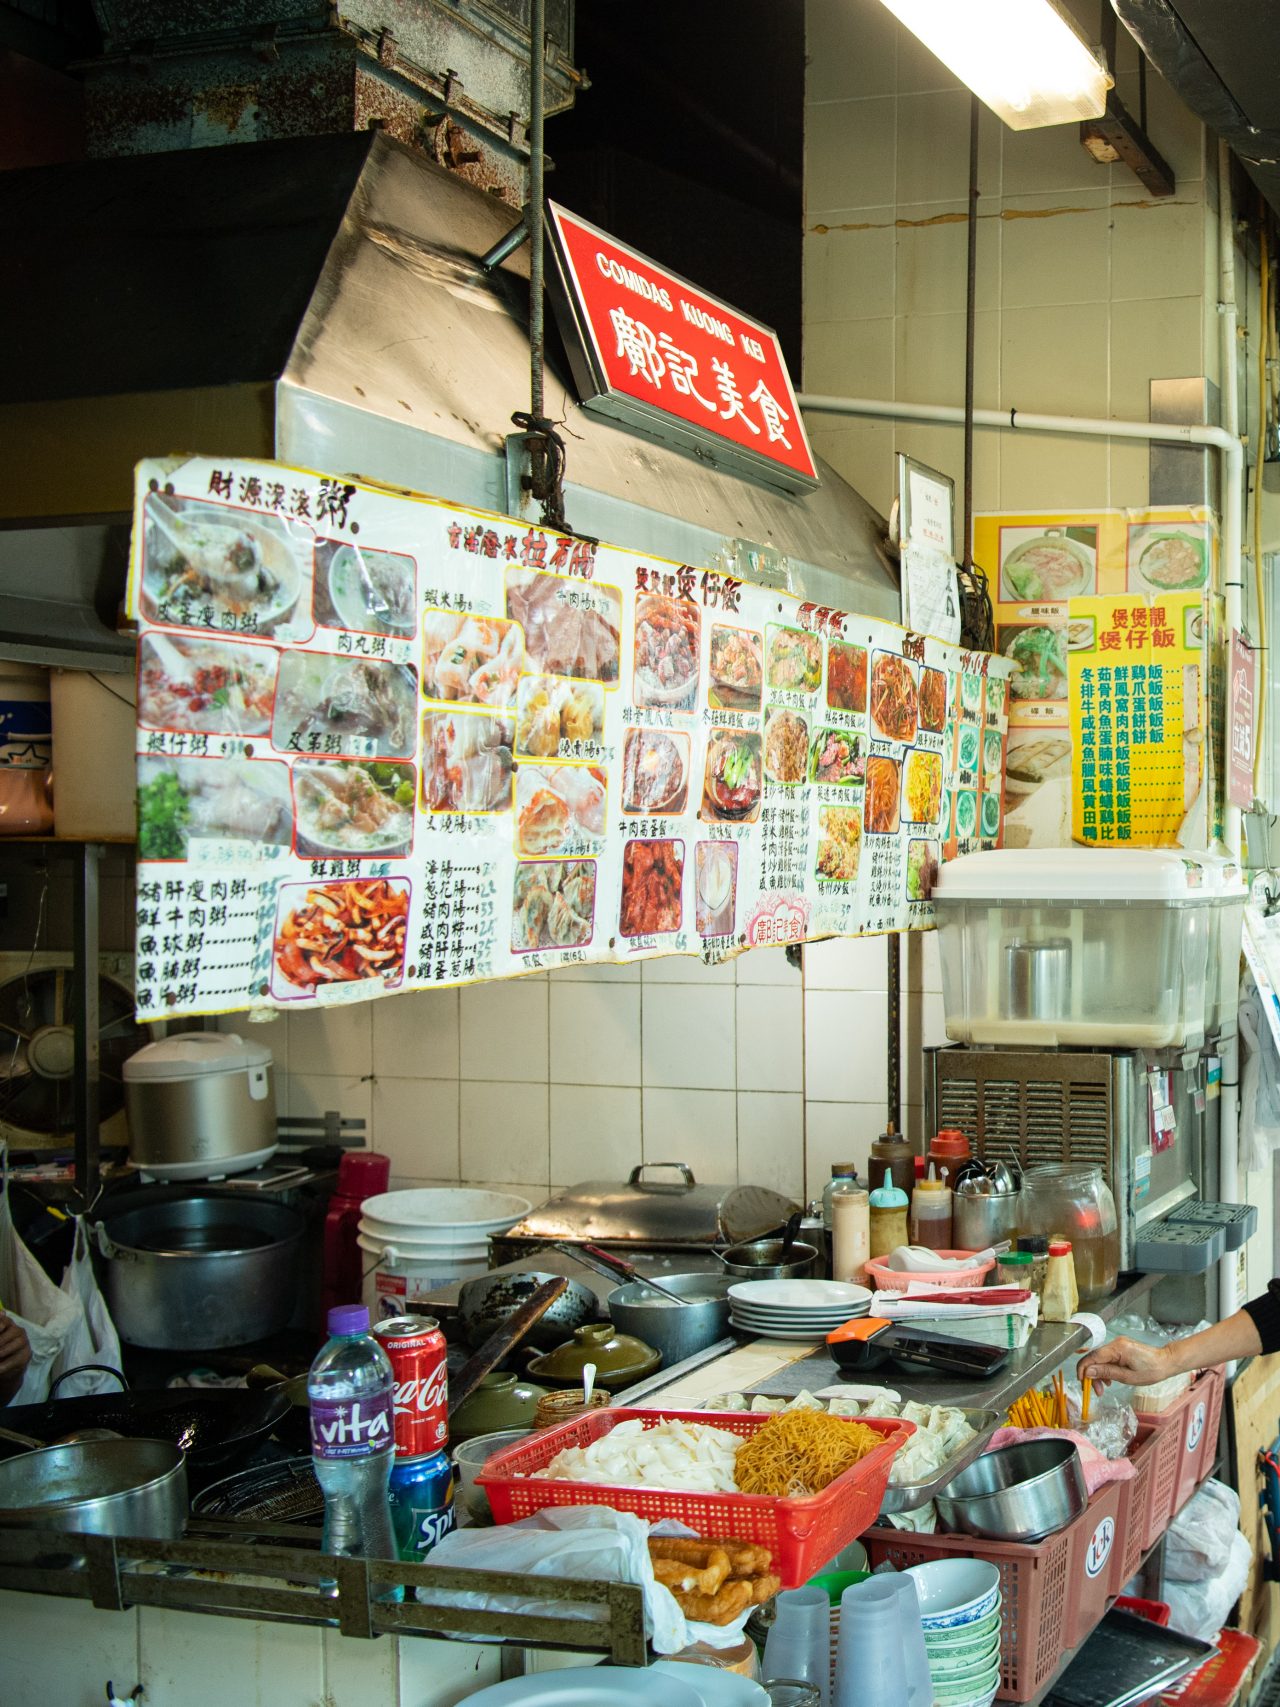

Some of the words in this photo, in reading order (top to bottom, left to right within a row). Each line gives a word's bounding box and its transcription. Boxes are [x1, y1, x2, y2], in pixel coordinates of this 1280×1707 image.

[596, 253, 673, 312] COMIDAS
[680, 300, 735, 346] KUONG
[740, 334, 766, 363] KEI
[1111, 607, 1167, 630] 煲煲靚
[1099, 628, 1176, 651] 煲仔飯
[1081, 681, 1163, 699] 排骨鳳爪飯
[1081, 697, 1164, 715] 牛肉窩蛋飯
[1081, 713, 1164, 731] 咸魚肉餅飯
[1081, 729, 1164, 747] 咸蛋肉餅飯
[1081, 745, 1131, 762] 魚腩飯
[387, 1339, 428, 1350] ORIGINAL
[320, 1403, 390, 1443] vita
